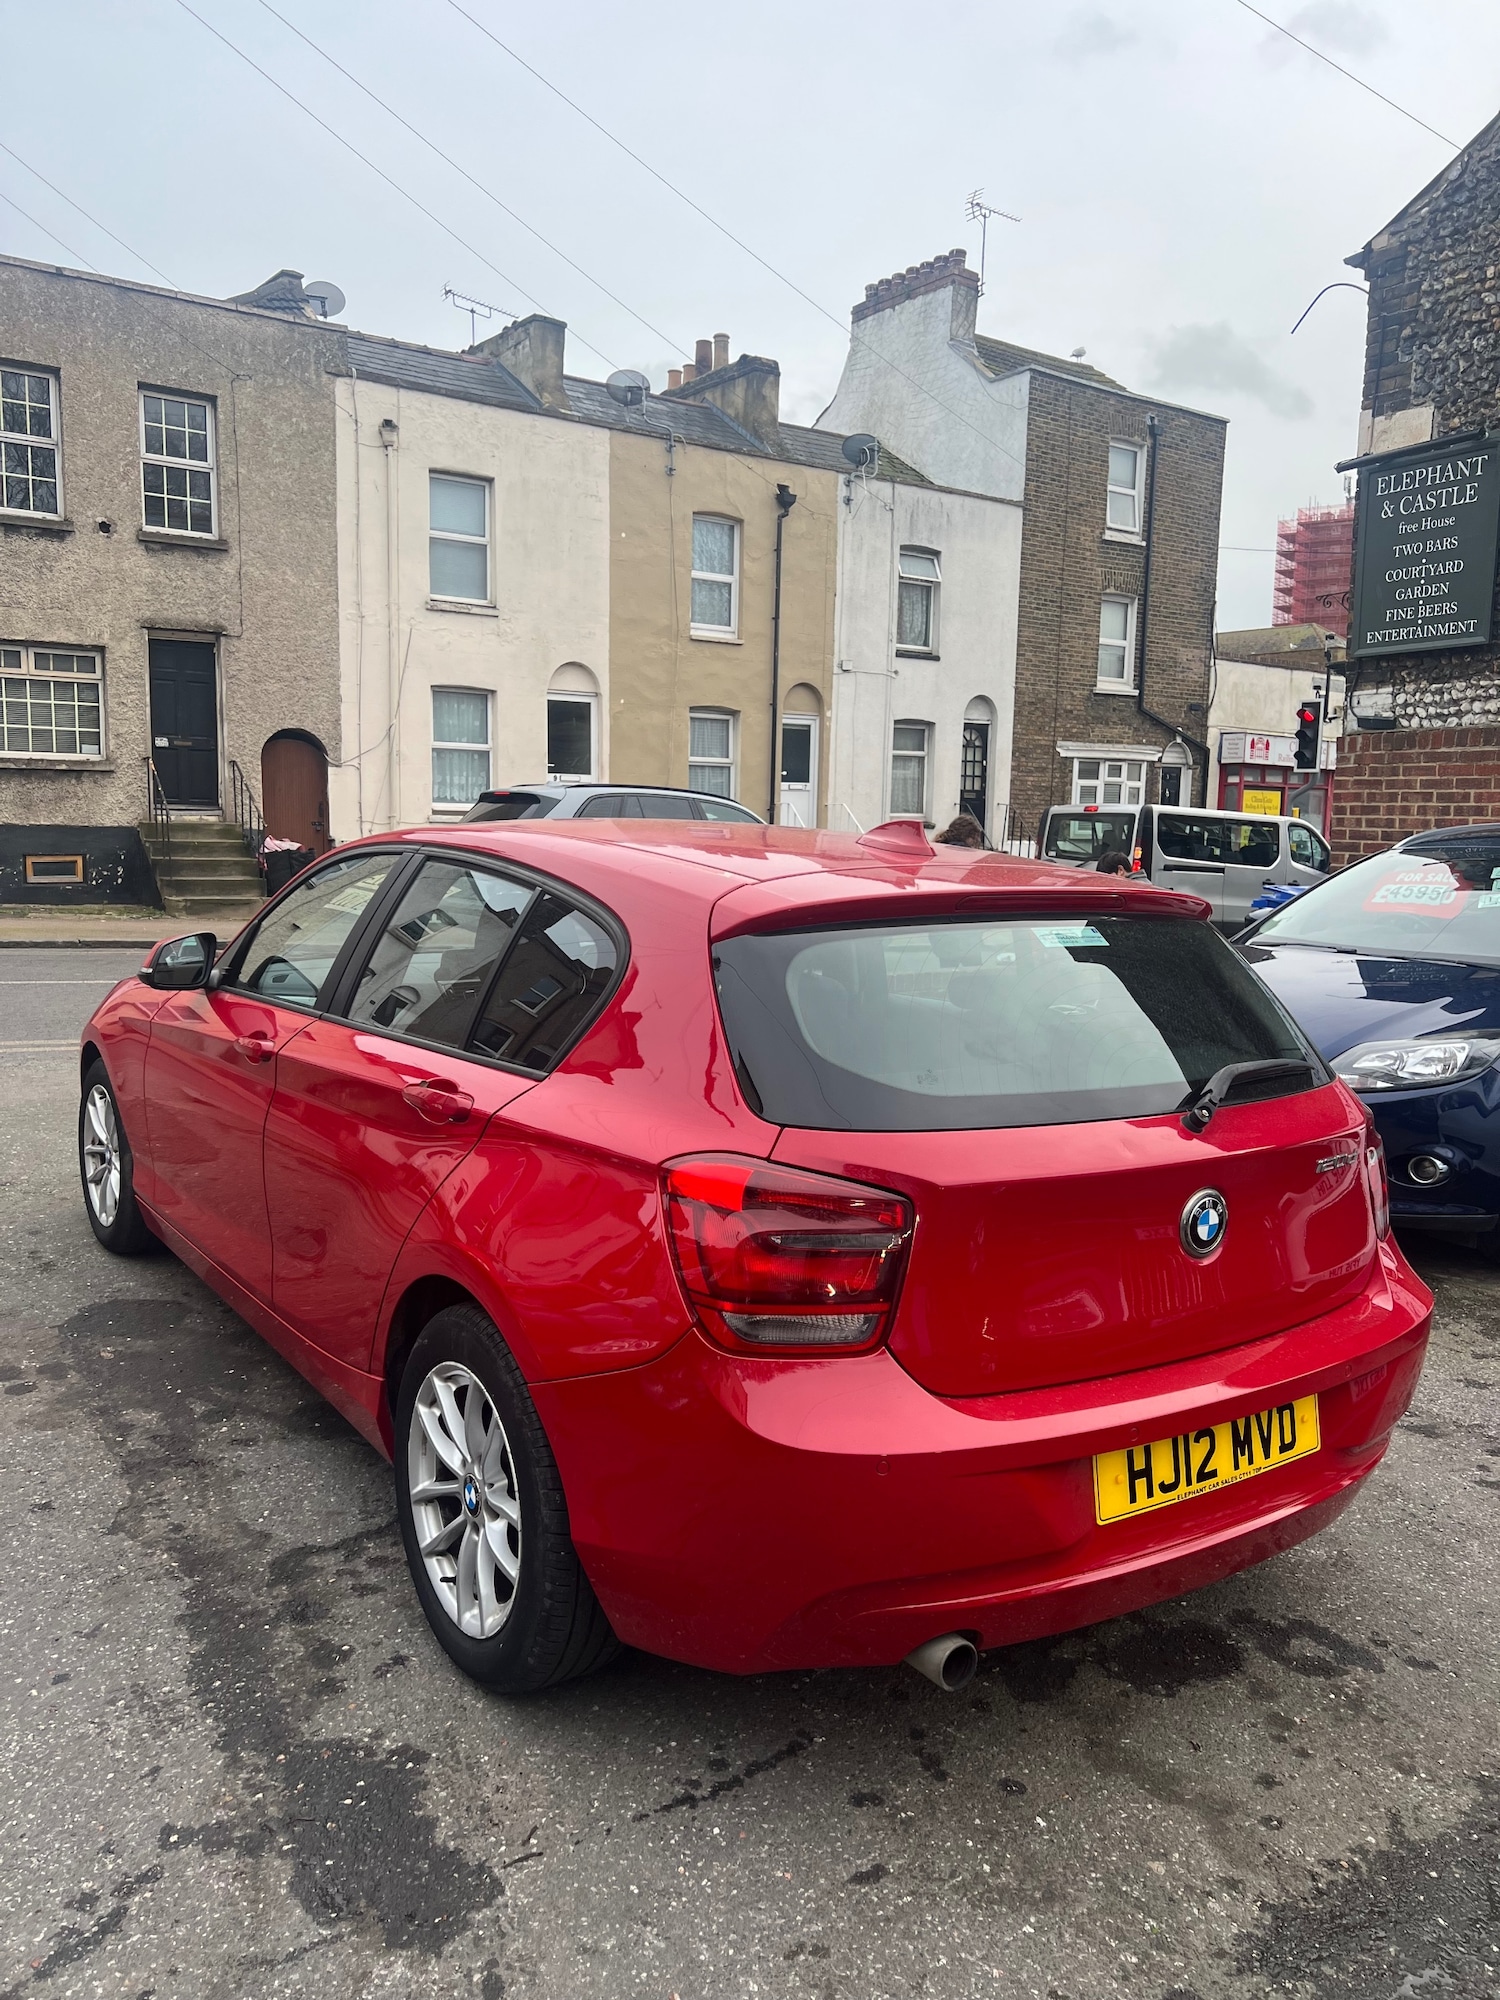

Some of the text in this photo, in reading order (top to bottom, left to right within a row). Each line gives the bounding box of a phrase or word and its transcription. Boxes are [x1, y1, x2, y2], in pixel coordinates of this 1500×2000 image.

[1376, 454, 1489, 497] ELEPHANT
[1381, 482, 1479, 519] & CASTLE
[1398, 515, 1456, 535] free House
[1393, 536, 1459, 558] TWO BARS
[1385, 559, 1464, 583] COURTYARD
[1395, 582, 1450, 601] GARDEN
[1385, 601, 1458, 622] FINE BEERS
[1366, 619, 1478, 644] ENTERTAINMENT
[1395, 872, 1460, 883] FOR SALE
[1194, 1199, 1223, 1218] BMW
[1126, 1401, 1297, 1505] HJ12 MVD
[1176, 1485, 1207, 1501] ELEPHANT
[1208, 1481, 1221, 1491] CAR
[1220, 1475, 1238, 1487] SALES
[1238, 1470, 1252, 1481] CT11
